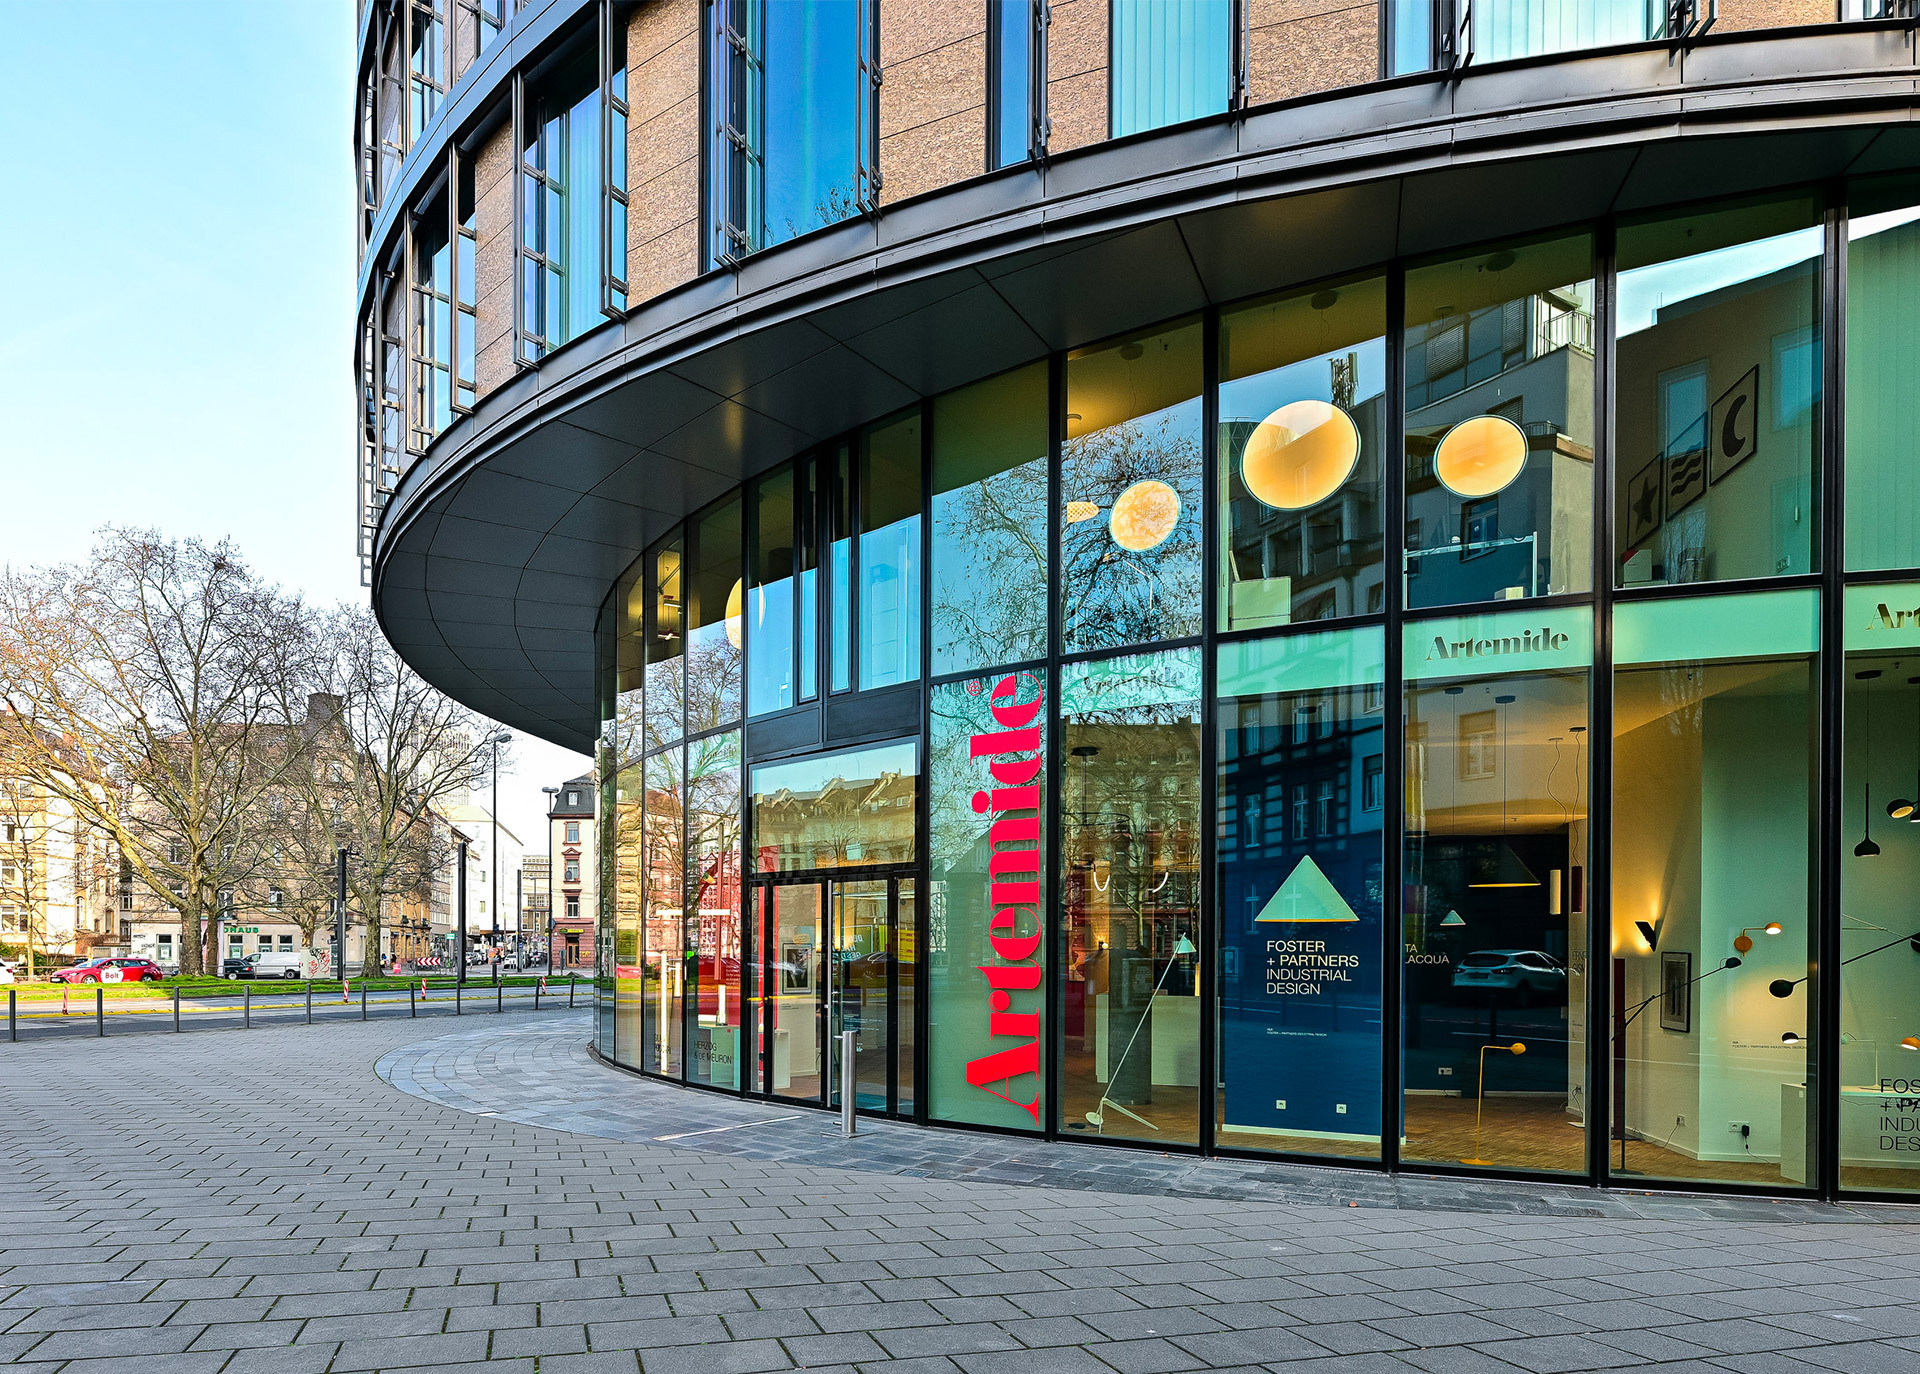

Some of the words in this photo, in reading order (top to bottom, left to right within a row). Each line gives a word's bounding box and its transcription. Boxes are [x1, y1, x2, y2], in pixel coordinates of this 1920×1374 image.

[1424, 627, 1569, 660] Artemide
[1266, 940, 1326, 952] FOSTER
[1266, 957, 1275, 966] +
[1280, 954, 1359, 967] PARTNERS
[1266, 968, 1352, 982] INDUSTRIAL
[1266, 982, 1321, 995] DESIGN
[1880, 1078, 1920, 1094] FOS
[1880, 1136, 1920, 1152] DES
